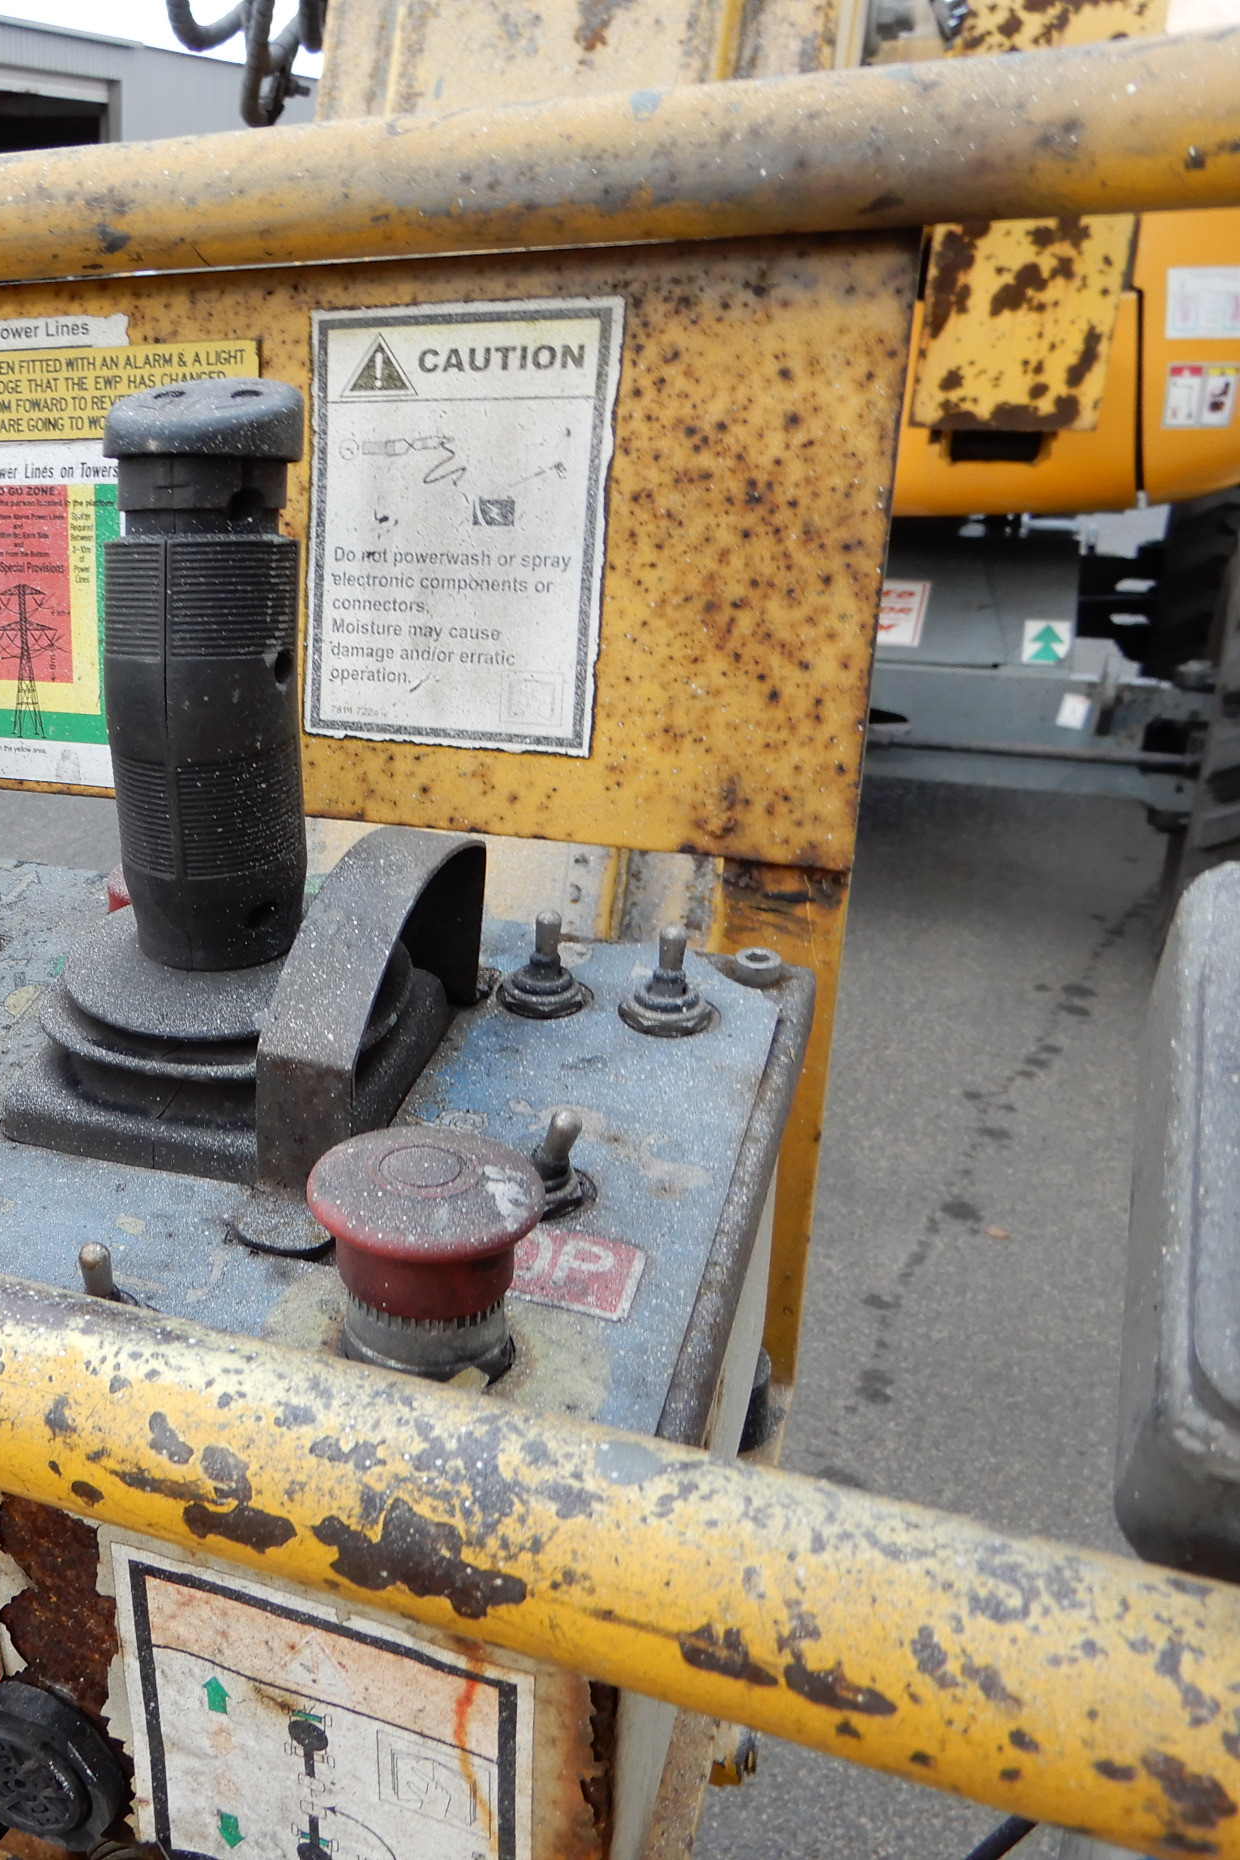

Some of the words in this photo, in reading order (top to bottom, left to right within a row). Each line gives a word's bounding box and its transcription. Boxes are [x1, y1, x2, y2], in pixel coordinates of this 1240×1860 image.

[46, 320, 90, 337] Lines
[19, 358, 62, 374] FITTED
[65, 356, 96, 372] WITH
[100, 355, 119, 371] AN
[124, 353, 173, 369] ALARM
[177, 352, 187, 367] &
[192, 351, 202, 366] A
[206, 349, 246, 366] LIGHT
[418, 345, 585, 373] CAUTION
[27, 378, 59, 393] THAT
[64, 377, 88, 392] THE
[94, 375, 122, 390] EWP
[128, 374, 156, 389] HAS
[16, 397, 68, 413] FOWARD
[71, 396, 87, 412] TO
[0, 418, 24, 433] ARE
[27, 416, 65, 432] GOING
[68, 416, 84, 431] TO
[24, 463, 54, 479] Lines
[60, 466, 74, 479] on
[80, 462, 118, 479] Towers
[8, 487, 23, 496] GO
[26, 487, 55, 496] ZONE
[0, 561, 25, 575] Special
[26, 561, 65, 573] Provisions
[334, 547, 356, 562] Do
[361, 548, 387, 563] not
[393, 549, 491, 567] powerwash
[497, 555, 516, 567] or
[520, 555, 572, 572] spray
[333, 573, 414, 589] electronic
[420, 577, 528, 593] components
[534, 581, 553, 593] or
[332, 618, 402, 636] Moisture
[409, 624, 442, 641] may
[449, 627, 501, 641] cause
[331, 642, 394, 662] damage
[400, 646, 454, 663] and/or
[459, 650, 516, 666] erratic
[331, 667, 411, 684] operation.
[514, 1230, 614, 1287] OP
